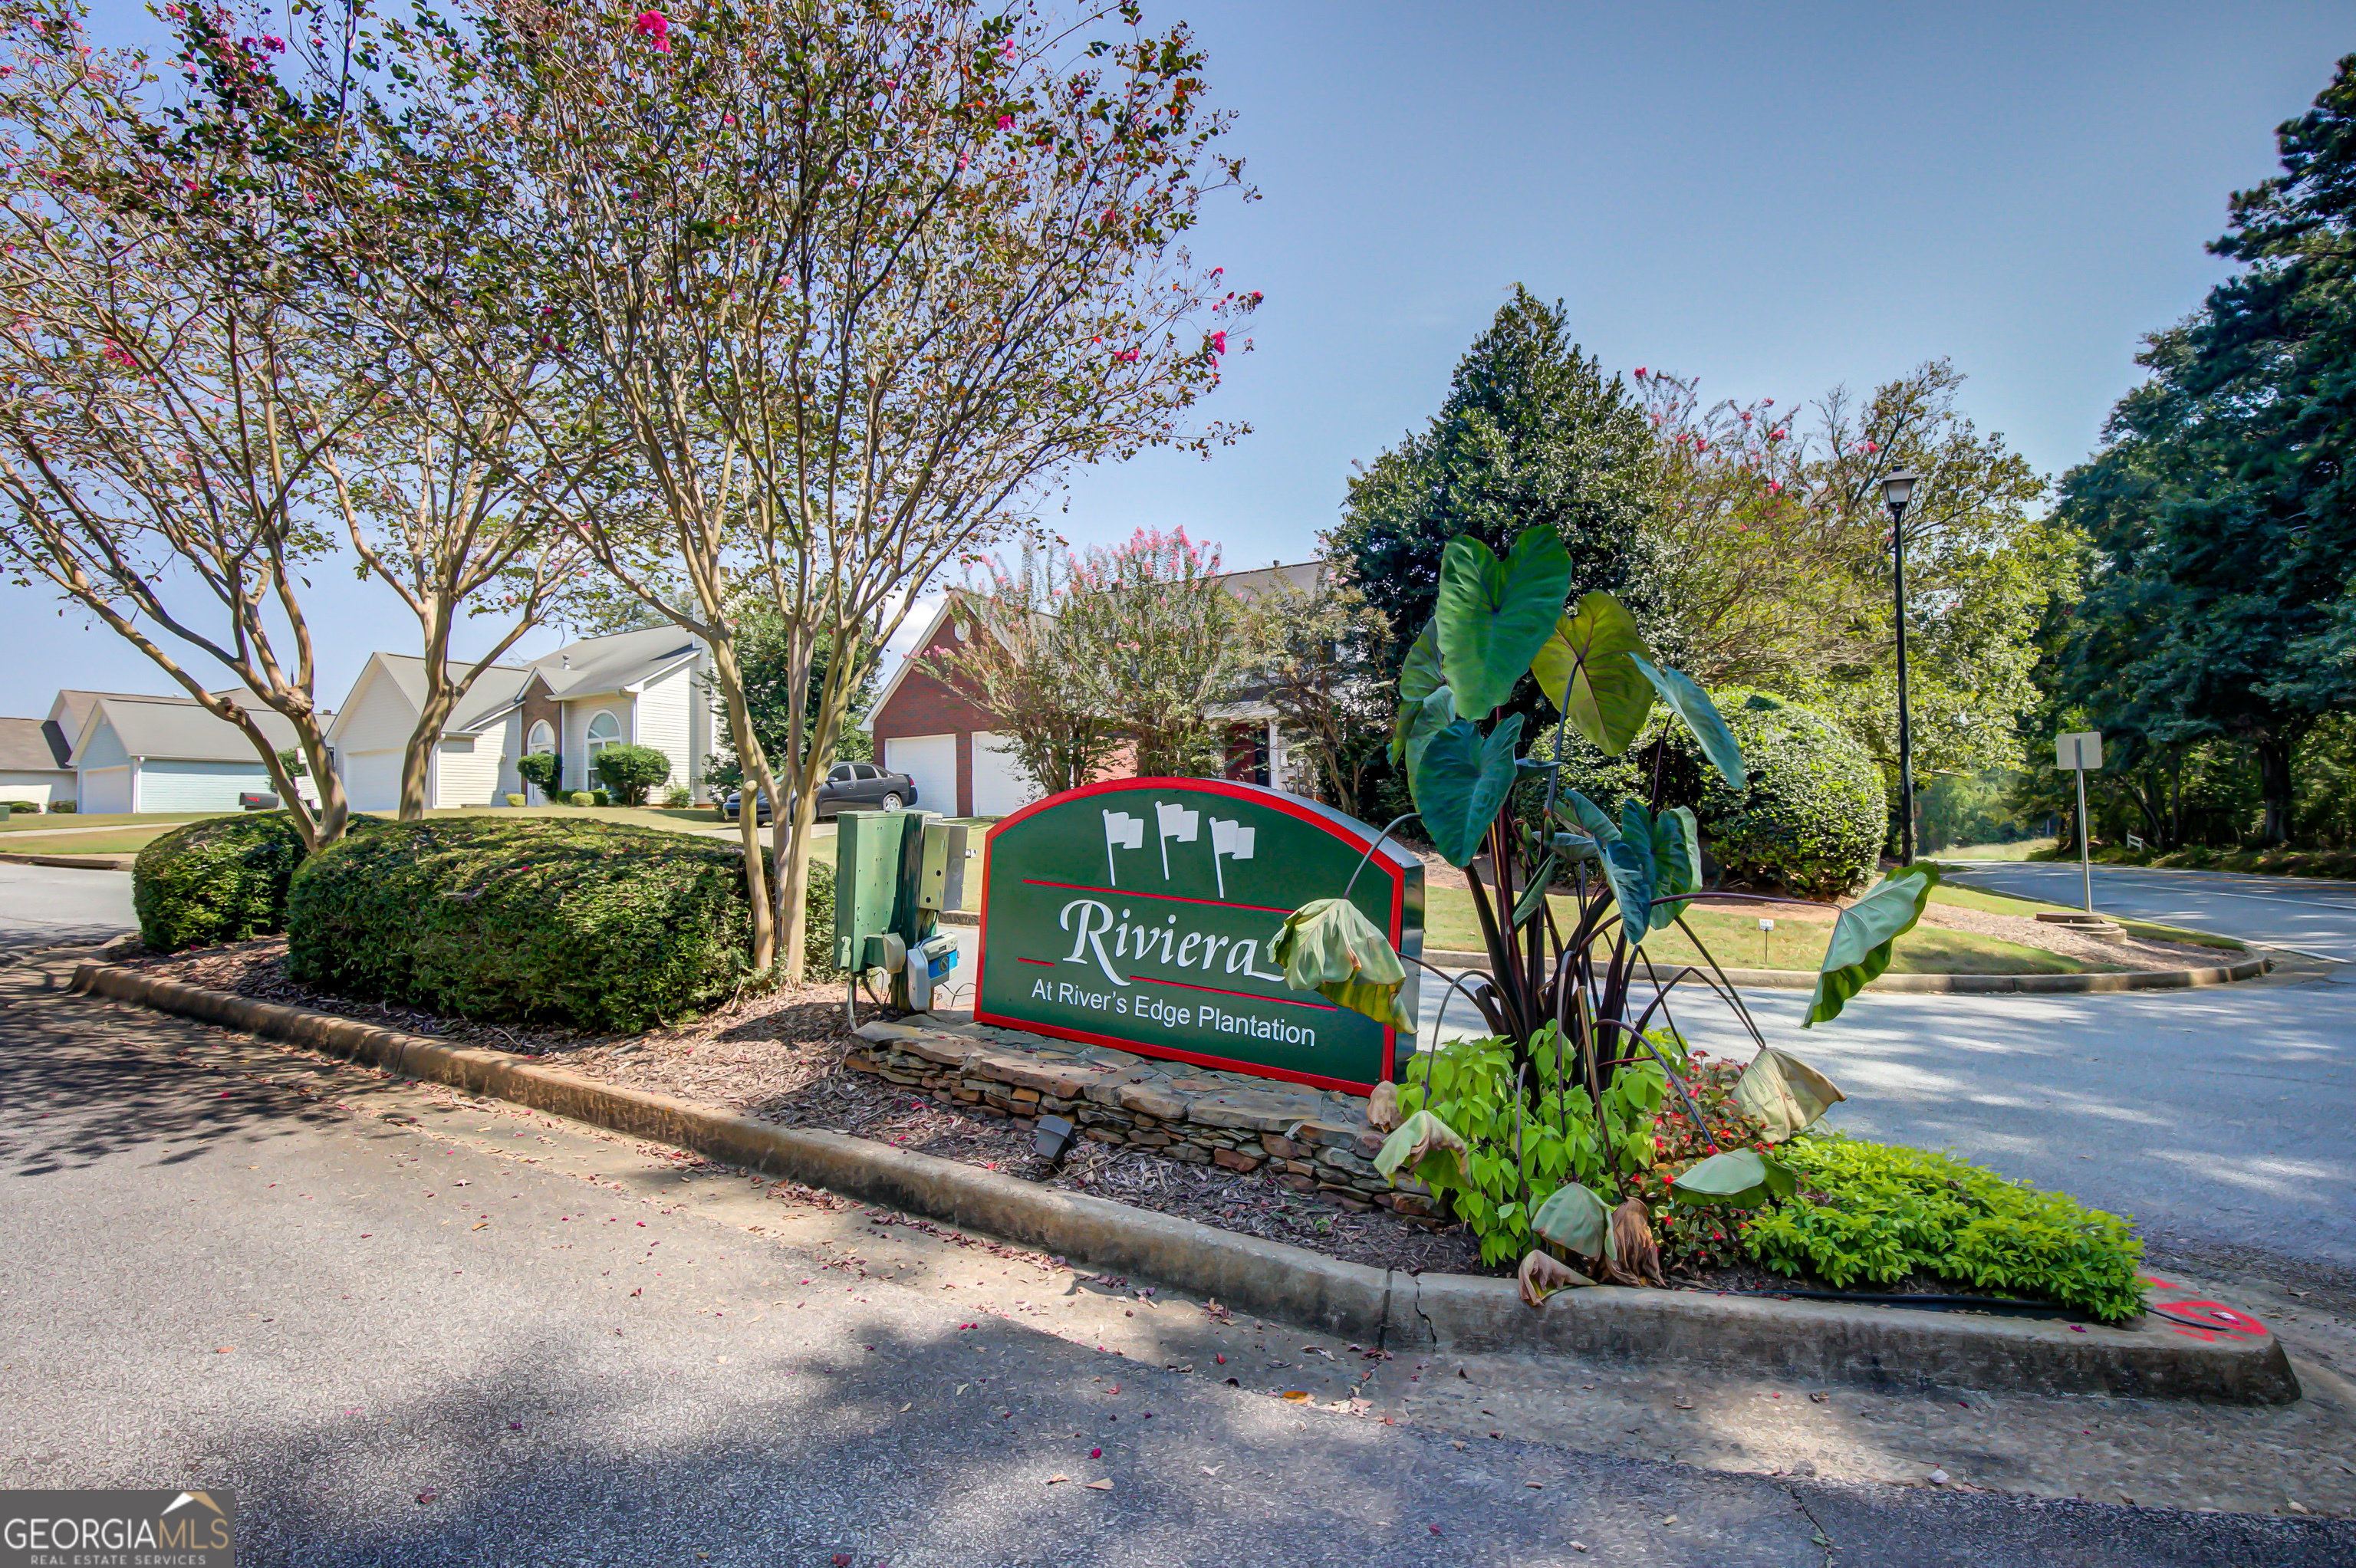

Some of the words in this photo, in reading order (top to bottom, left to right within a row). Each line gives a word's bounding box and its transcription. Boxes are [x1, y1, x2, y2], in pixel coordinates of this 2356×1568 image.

[1060, 899, 1286, 986] Riviera
[1032, 978, 1053, 1001] At
[1058, 982, 1127, 1014] River's
[1134, 994, 1191, 1028] Edge
[1198, 1005, 1315, 1047] Plantation
